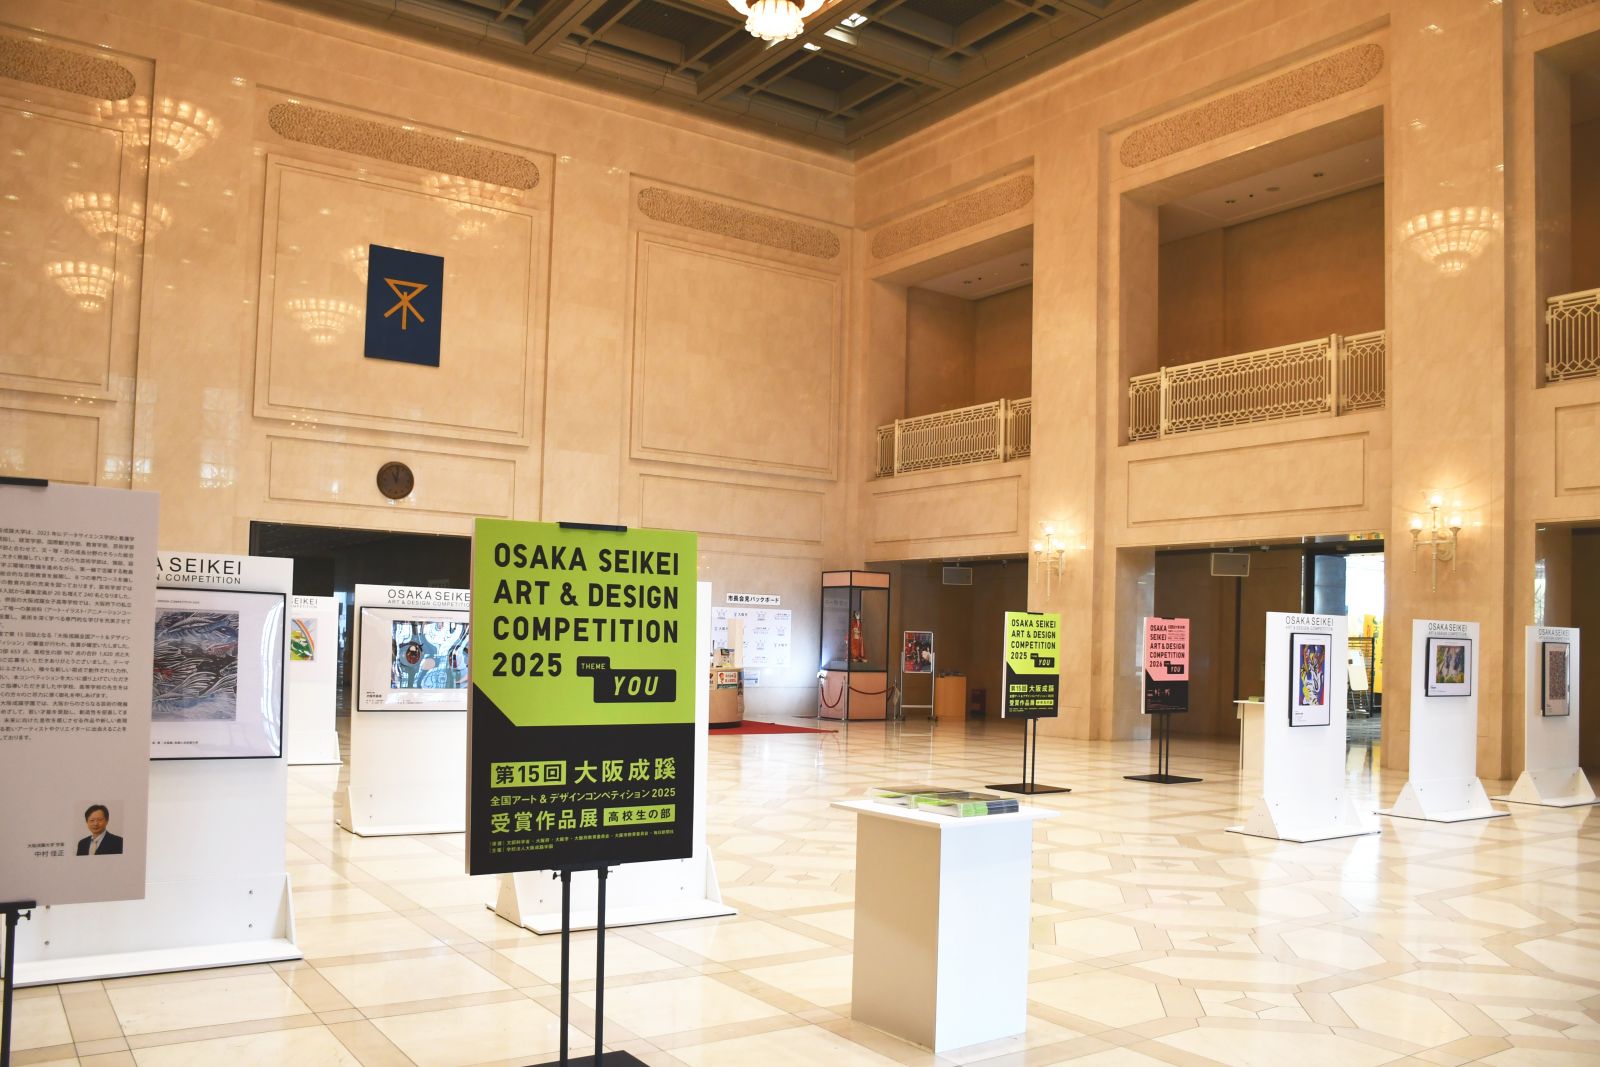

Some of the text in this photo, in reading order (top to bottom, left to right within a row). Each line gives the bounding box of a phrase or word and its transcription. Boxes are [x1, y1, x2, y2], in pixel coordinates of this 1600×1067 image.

[494, 542, 679, 576] OSAKA SEIKEI
[170, 558, 241, 574] SEIKEI
[166, 574, 240, 584] COMPETITION
[388, 589, 432, 600] OSAKA
[494, 580, 678, 610] ART & DESIGN
[291, 598, 318, 606] EIKEI
[1012, 619, 1056, 628] OSAKA SEIKEI
[1286, 616, 1334, 626] OSAKA SEIKEI
[494, 616, 678, 643] COMPETITION
[1428, 622, 1467, 632] OSAKA SEIKEI
[1033, 631, 1056, 639] DESIGN
[1011, 641, 1056, 649] COMPETITION
[492, 652, 562, 677] 2025
[581, 662, 606, 670] THEME
[613, 676, 659, 696] YOU
[496, 757, 676, 785] 第15回 大阪成蹊
[652, 787, 676, 798] 2025
[490, 808, 672, 834] 受賞作品展 高校生の部
